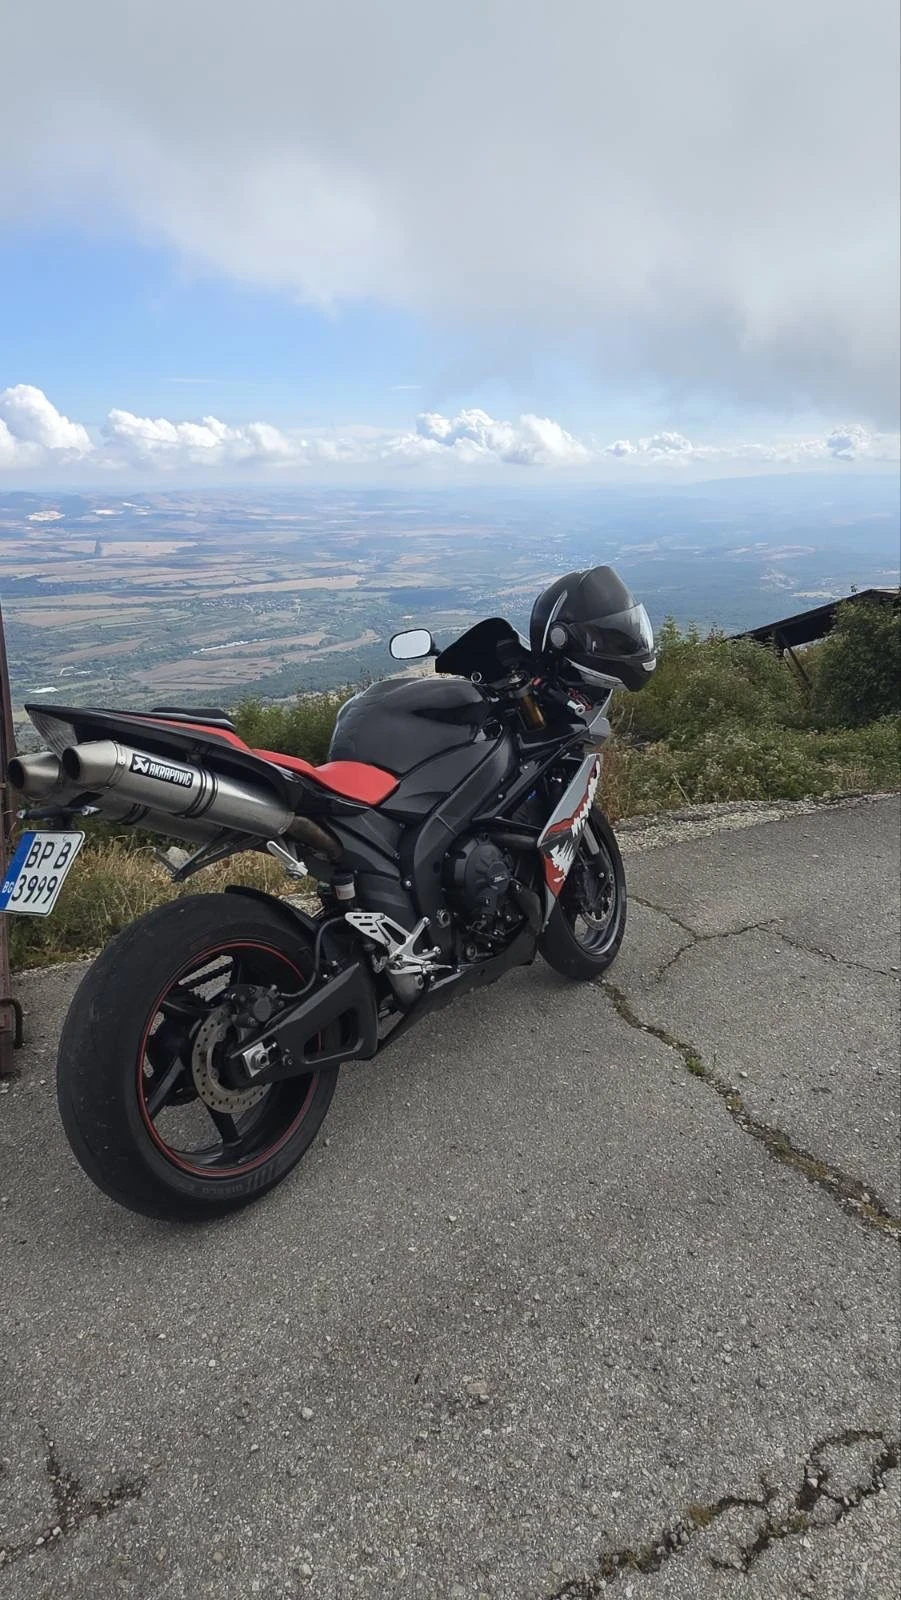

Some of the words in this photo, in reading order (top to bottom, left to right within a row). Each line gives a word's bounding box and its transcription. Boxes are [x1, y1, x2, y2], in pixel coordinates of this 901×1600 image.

[24, 841, 55, 869] BP
[53, 841, 72, 869] B
[1, 881, 15, 894] BG
[11, 874, 58, 904] 3999
